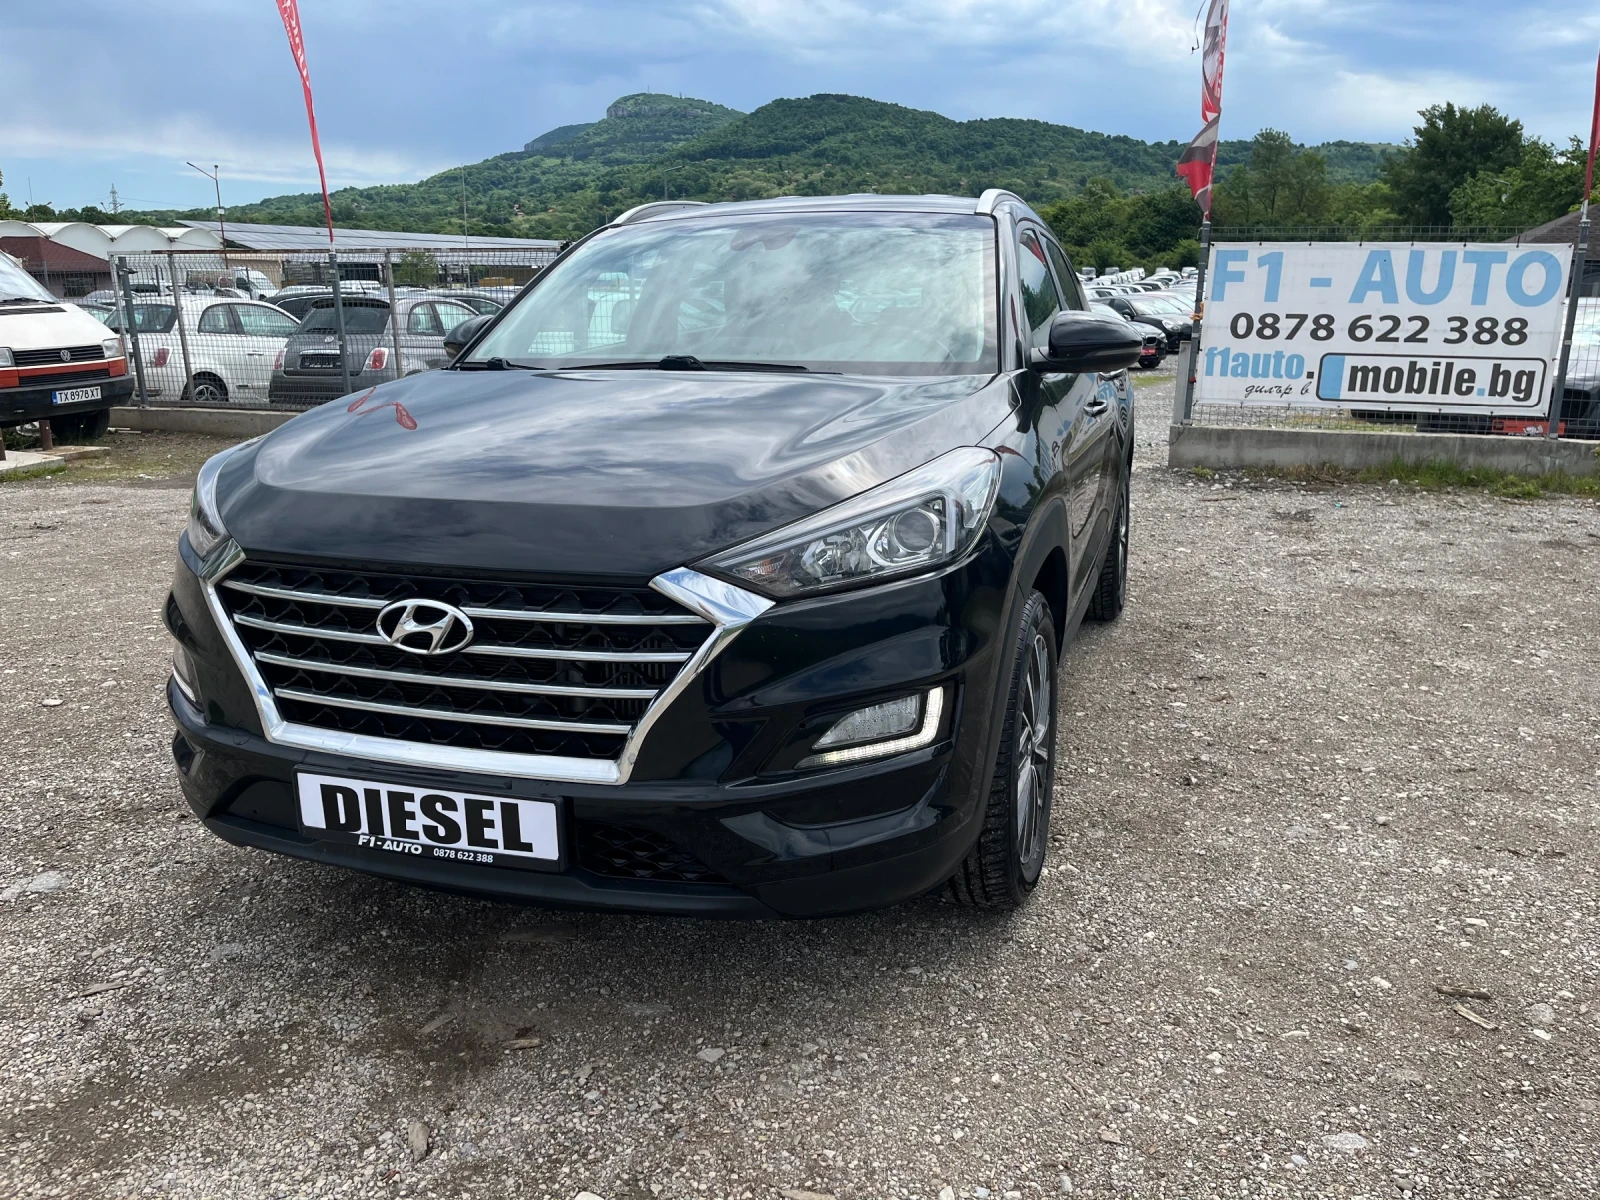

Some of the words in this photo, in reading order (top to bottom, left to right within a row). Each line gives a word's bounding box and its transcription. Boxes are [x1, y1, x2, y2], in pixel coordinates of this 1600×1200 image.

[1211, 249, 1284, 302] F1
[1348, 249, 1562, 307] AUTO
[1230, 312, 1335, 341] 0878
[1347, 314, 1429, 343] 622
[1442, 316, 1529, 346] 388
[70, 389, 89, 401] 8978
[1348, 360, 1536, 402] mobile.bg
[319, 783, 534, 853] DIESEL
[358, 835, 423, 855] F1-AUTO
[433, 847, 456, 859] 0878
[457, 851, 474, 861] 622
[476, 853, 494, 863] 388
